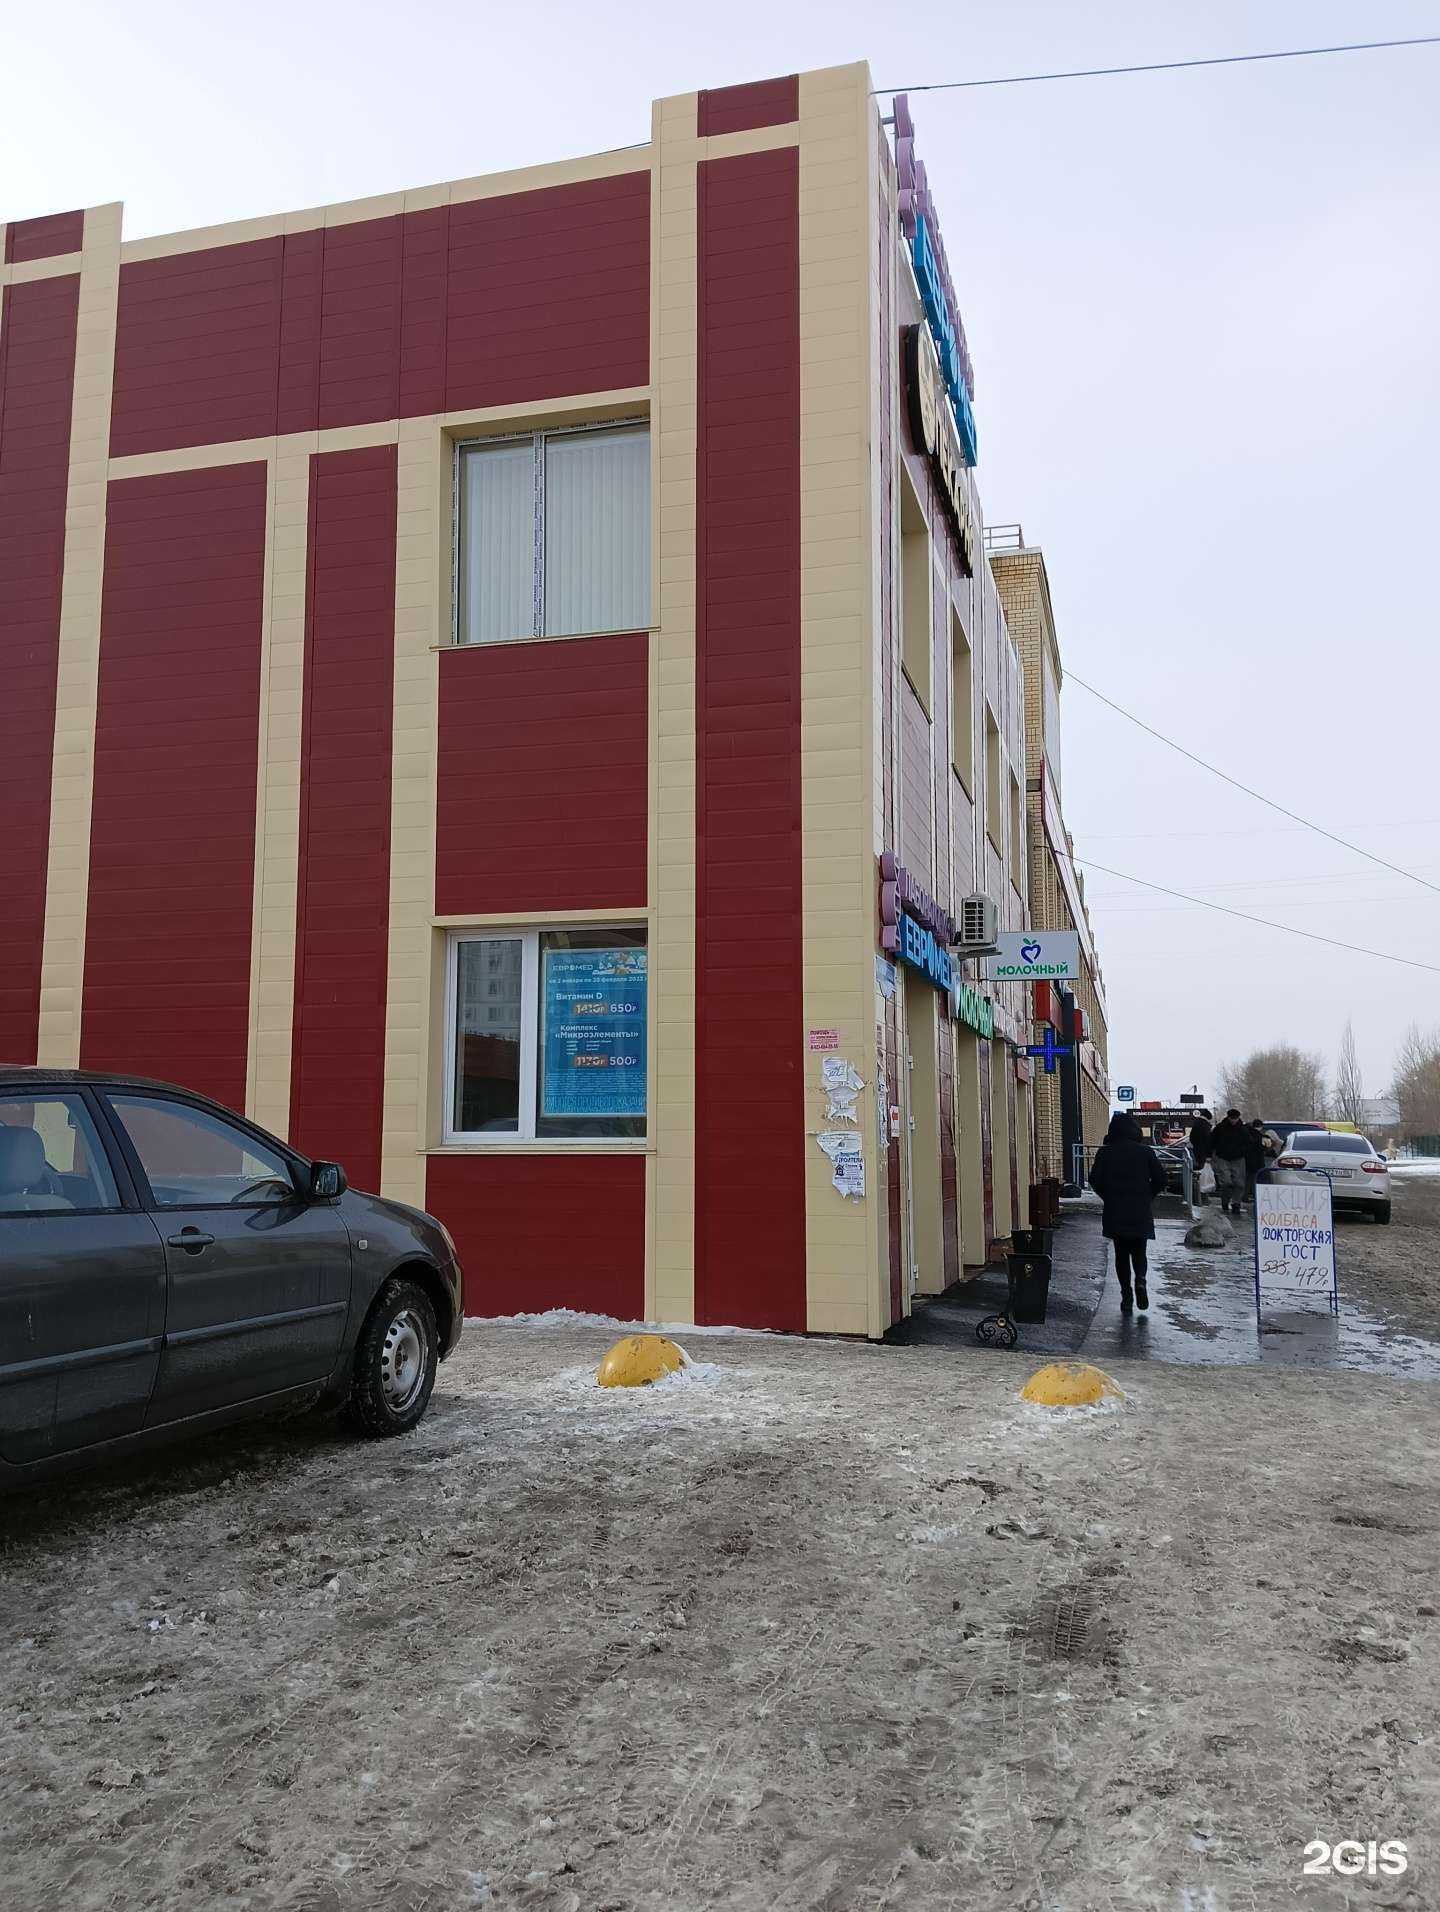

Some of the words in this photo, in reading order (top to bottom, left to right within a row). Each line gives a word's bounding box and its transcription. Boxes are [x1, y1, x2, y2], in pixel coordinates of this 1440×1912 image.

[997, 961, 1069, 976] МОЛОЧНЫЙ
[556, 993, 594, 1001] Витамин
[596, 992, 603, 1000] D
[555, 1031, 639, 1039] «Микроэлементы»
[1261, 1187, 1330, 1211] АКЦИЯ
[1260, 1213, 1318, 1229] КОЛБАСА
[1263, 1227, 1332, 1245] ДОКТОРСКАЯ
[1283, 1245, 1321, 1261] ГОСТ
